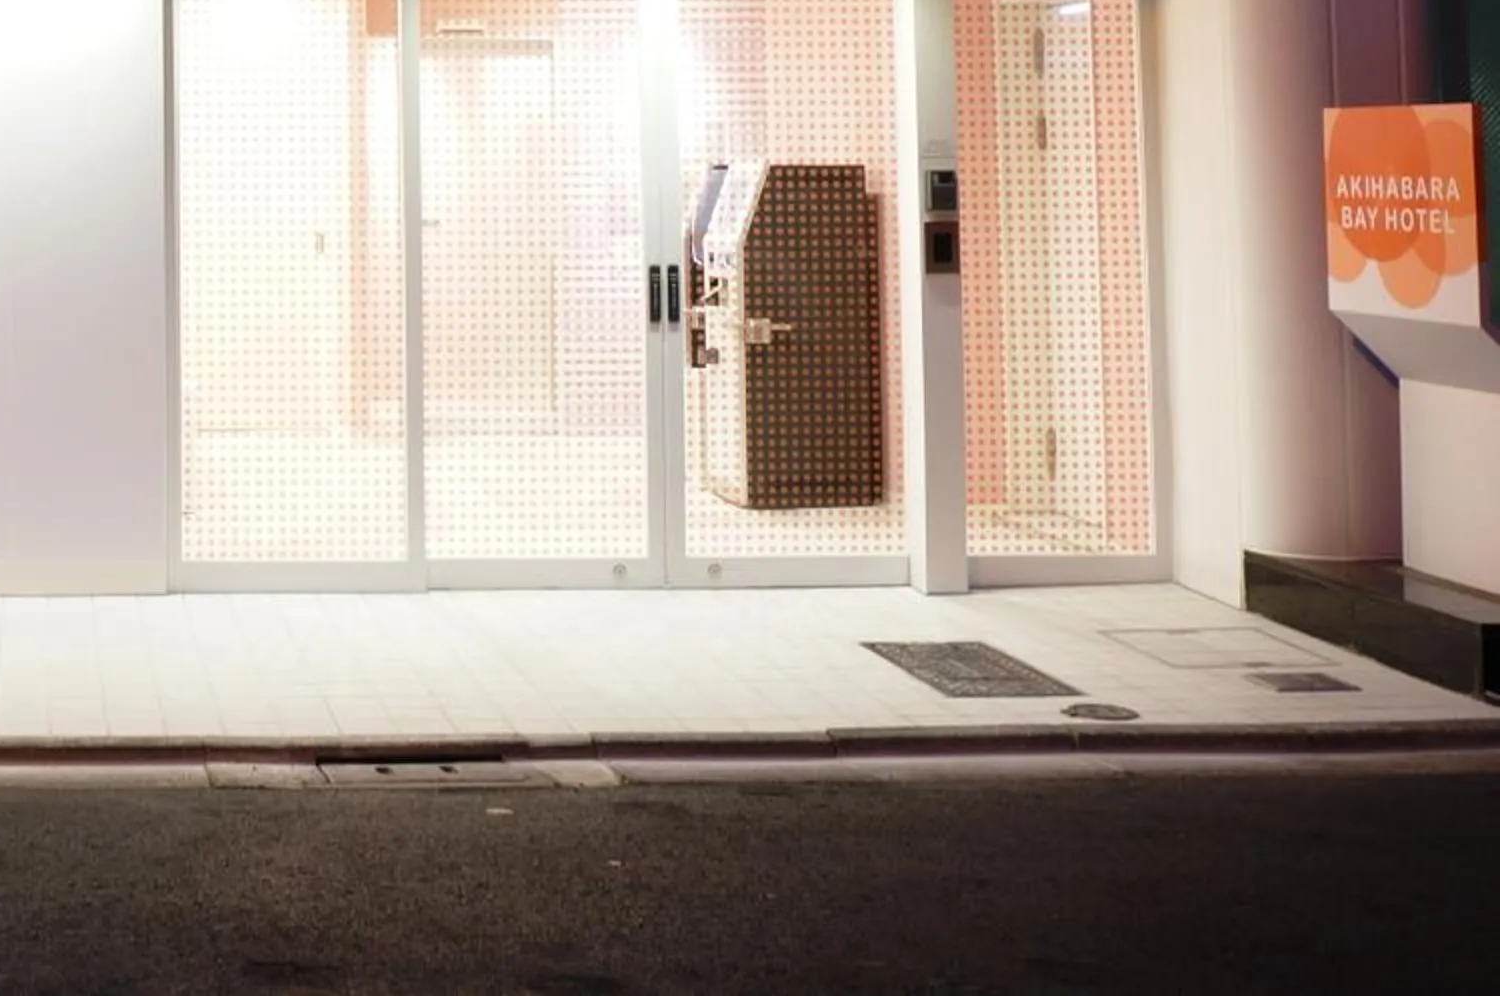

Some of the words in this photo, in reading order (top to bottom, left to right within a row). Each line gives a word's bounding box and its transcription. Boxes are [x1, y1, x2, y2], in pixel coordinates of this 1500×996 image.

[1336, 174, 1461, 202] AKIHABARA
[1340, 205, 1379, 231] BAY
[1385, 207, 1456, 235] HOTEL
